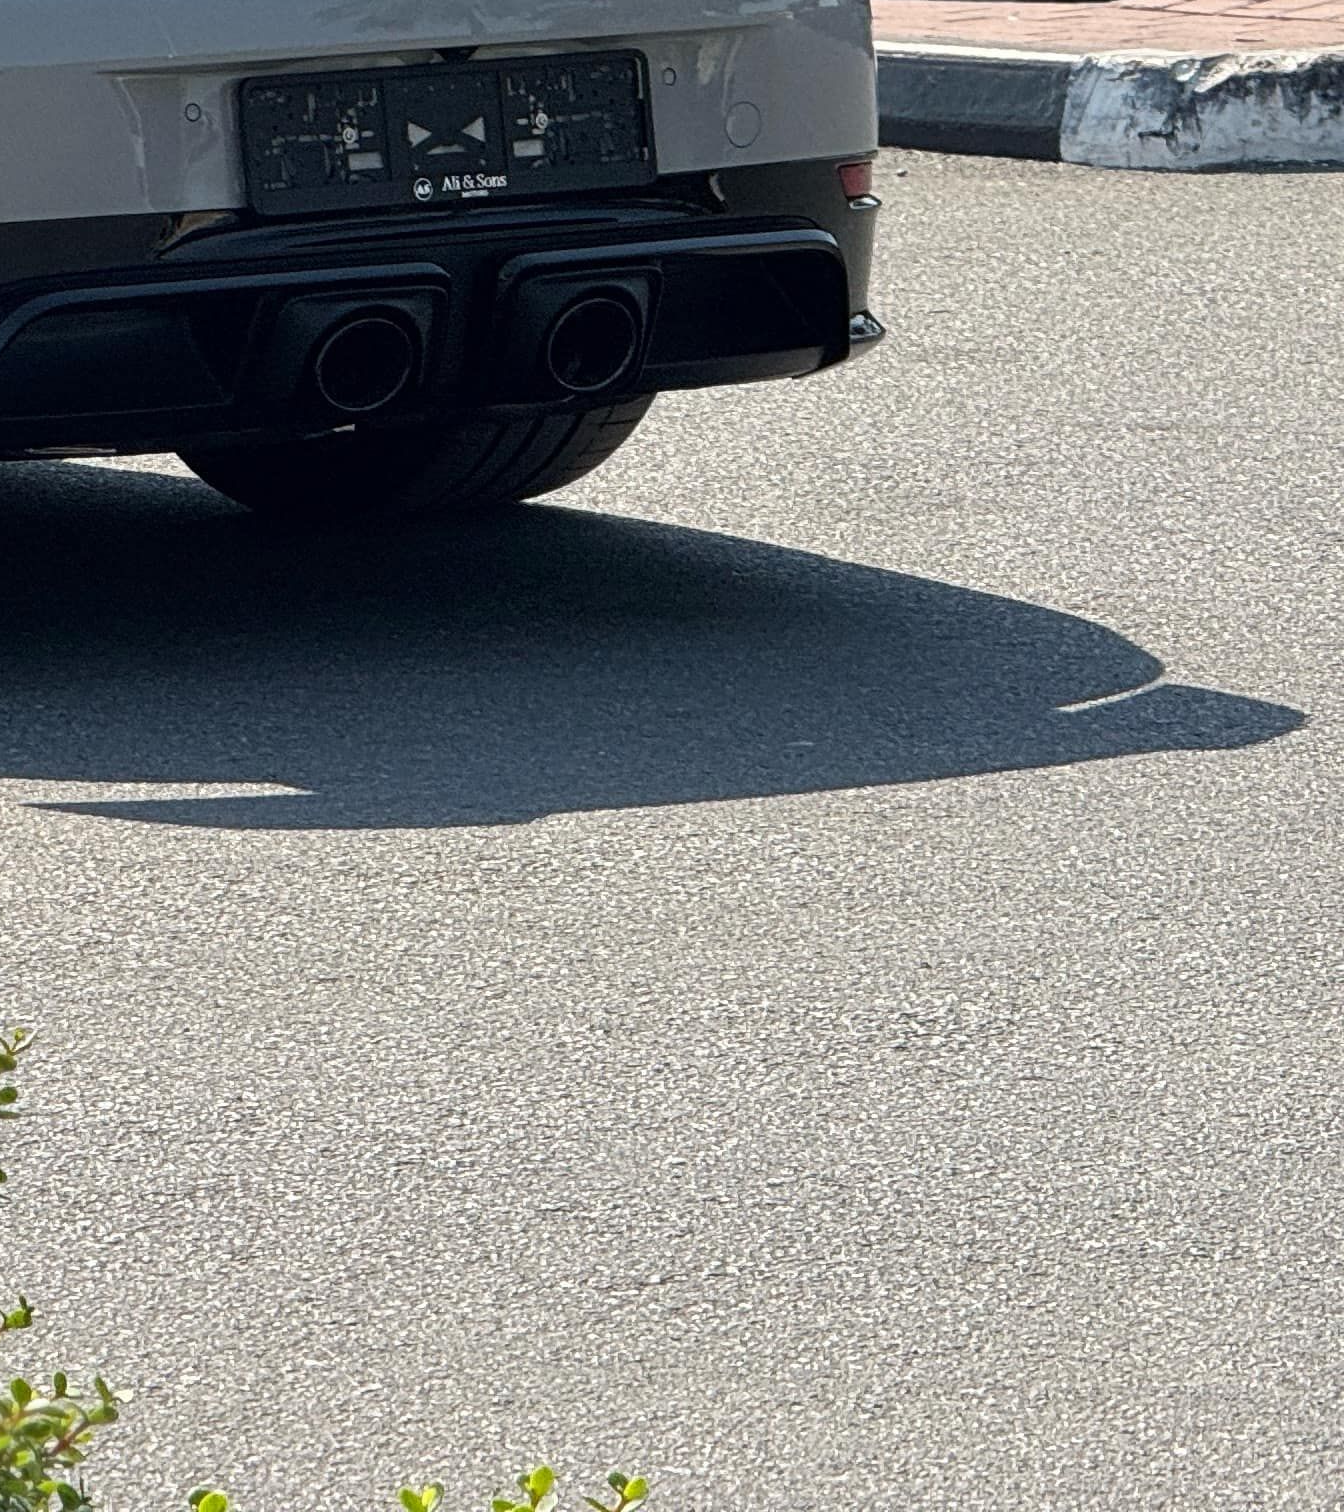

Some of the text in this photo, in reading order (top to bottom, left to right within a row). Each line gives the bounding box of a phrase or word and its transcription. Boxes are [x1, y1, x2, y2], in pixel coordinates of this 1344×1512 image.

[441, 172, 508, 192] Ali & Sons
